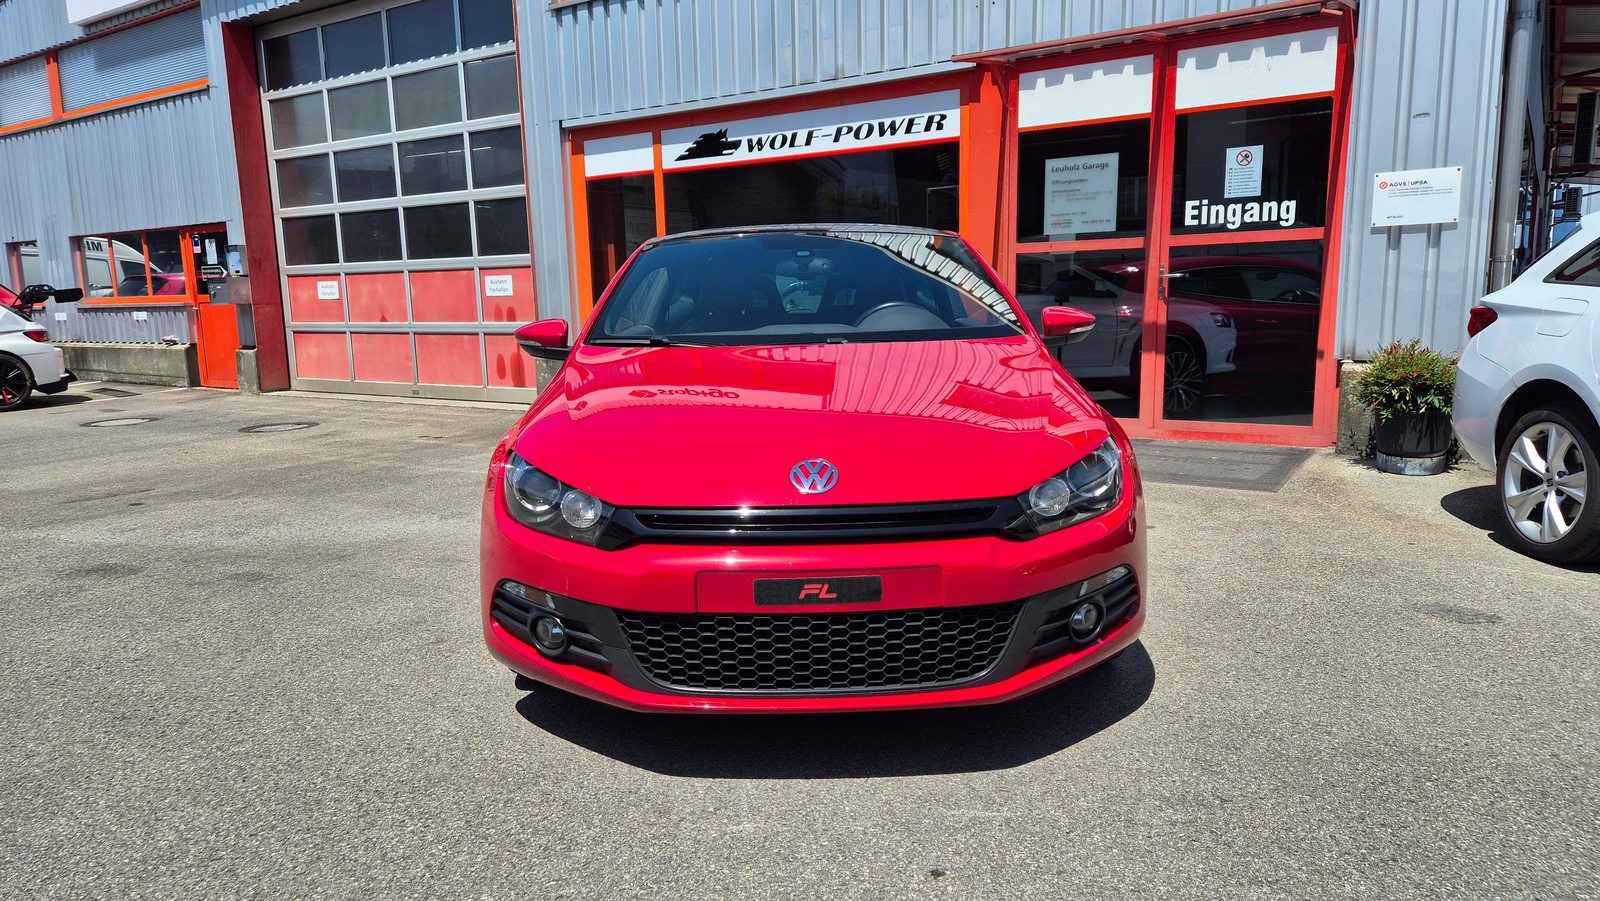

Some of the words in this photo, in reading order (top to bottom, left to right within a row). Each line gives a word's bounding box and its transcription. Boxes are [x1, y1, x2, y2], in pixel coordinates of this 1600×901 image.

[746, 113, 948, 153] WOLF-POWER
[1051, 164, 1080, 172] Leuholz
[1082, 161, 1110, 171] Garage
[1184, 199, 1296, 230] Eingang
[799, 583, 838, 600] FL
